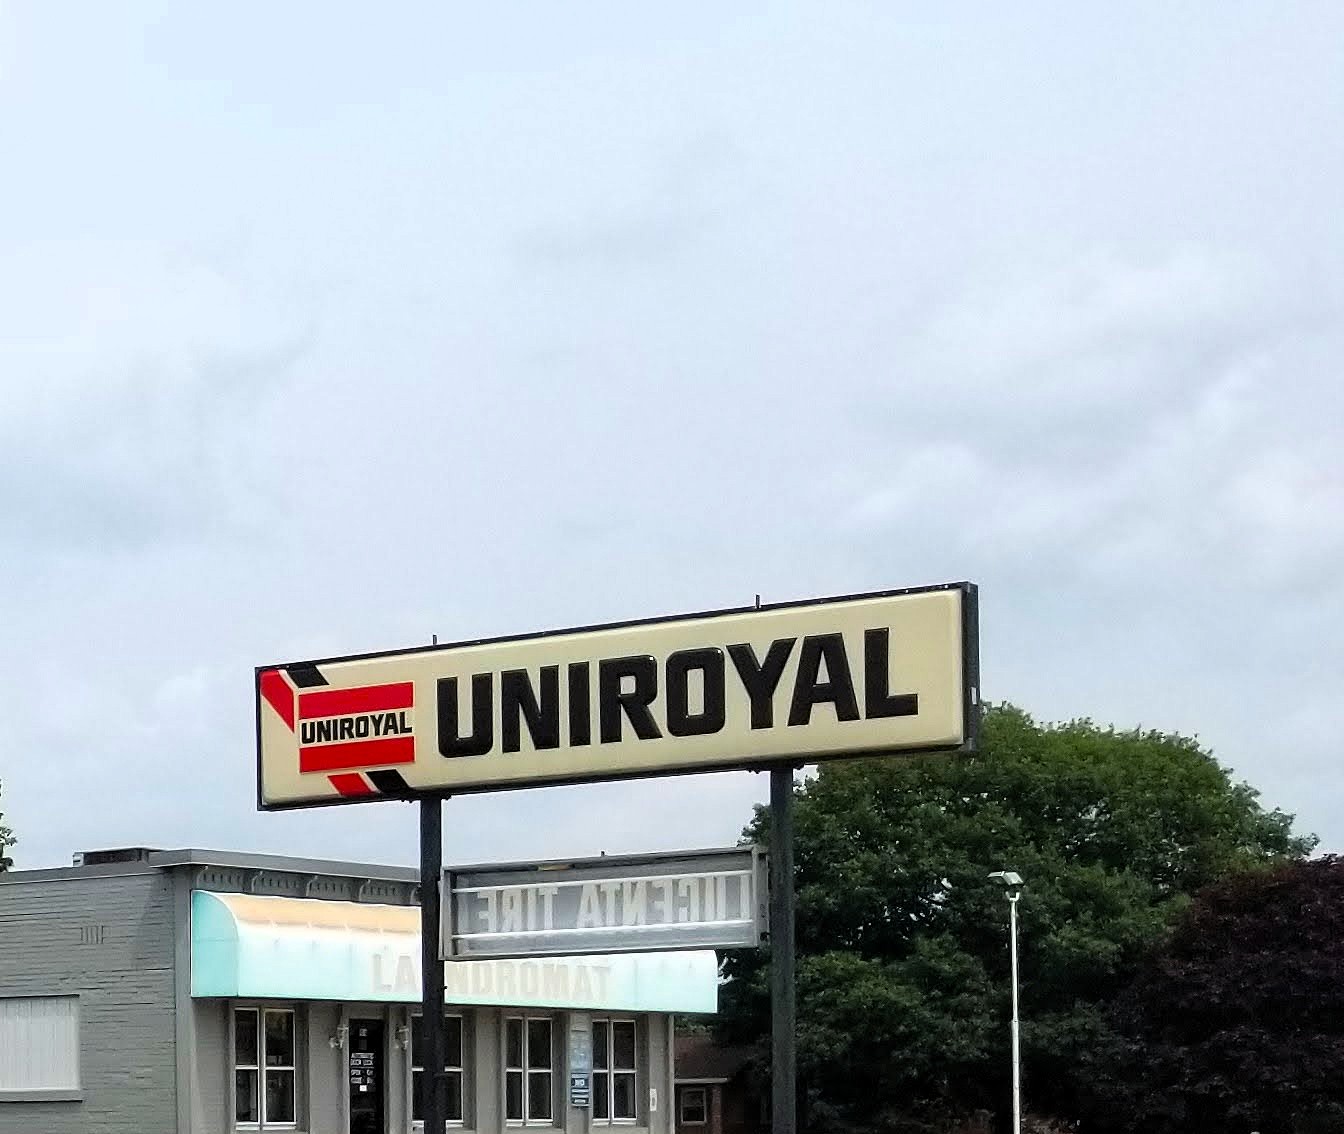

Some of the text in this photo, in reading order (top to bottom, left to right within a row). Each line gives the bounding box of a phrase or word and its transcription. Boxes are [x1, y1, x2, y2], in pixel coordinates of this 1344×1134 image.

[436, 627, 919, 758] UNIROYAL
[301, 712, 413, 744] UNIROYAL
[373, 954, 610, 1000] LANDROMAT
